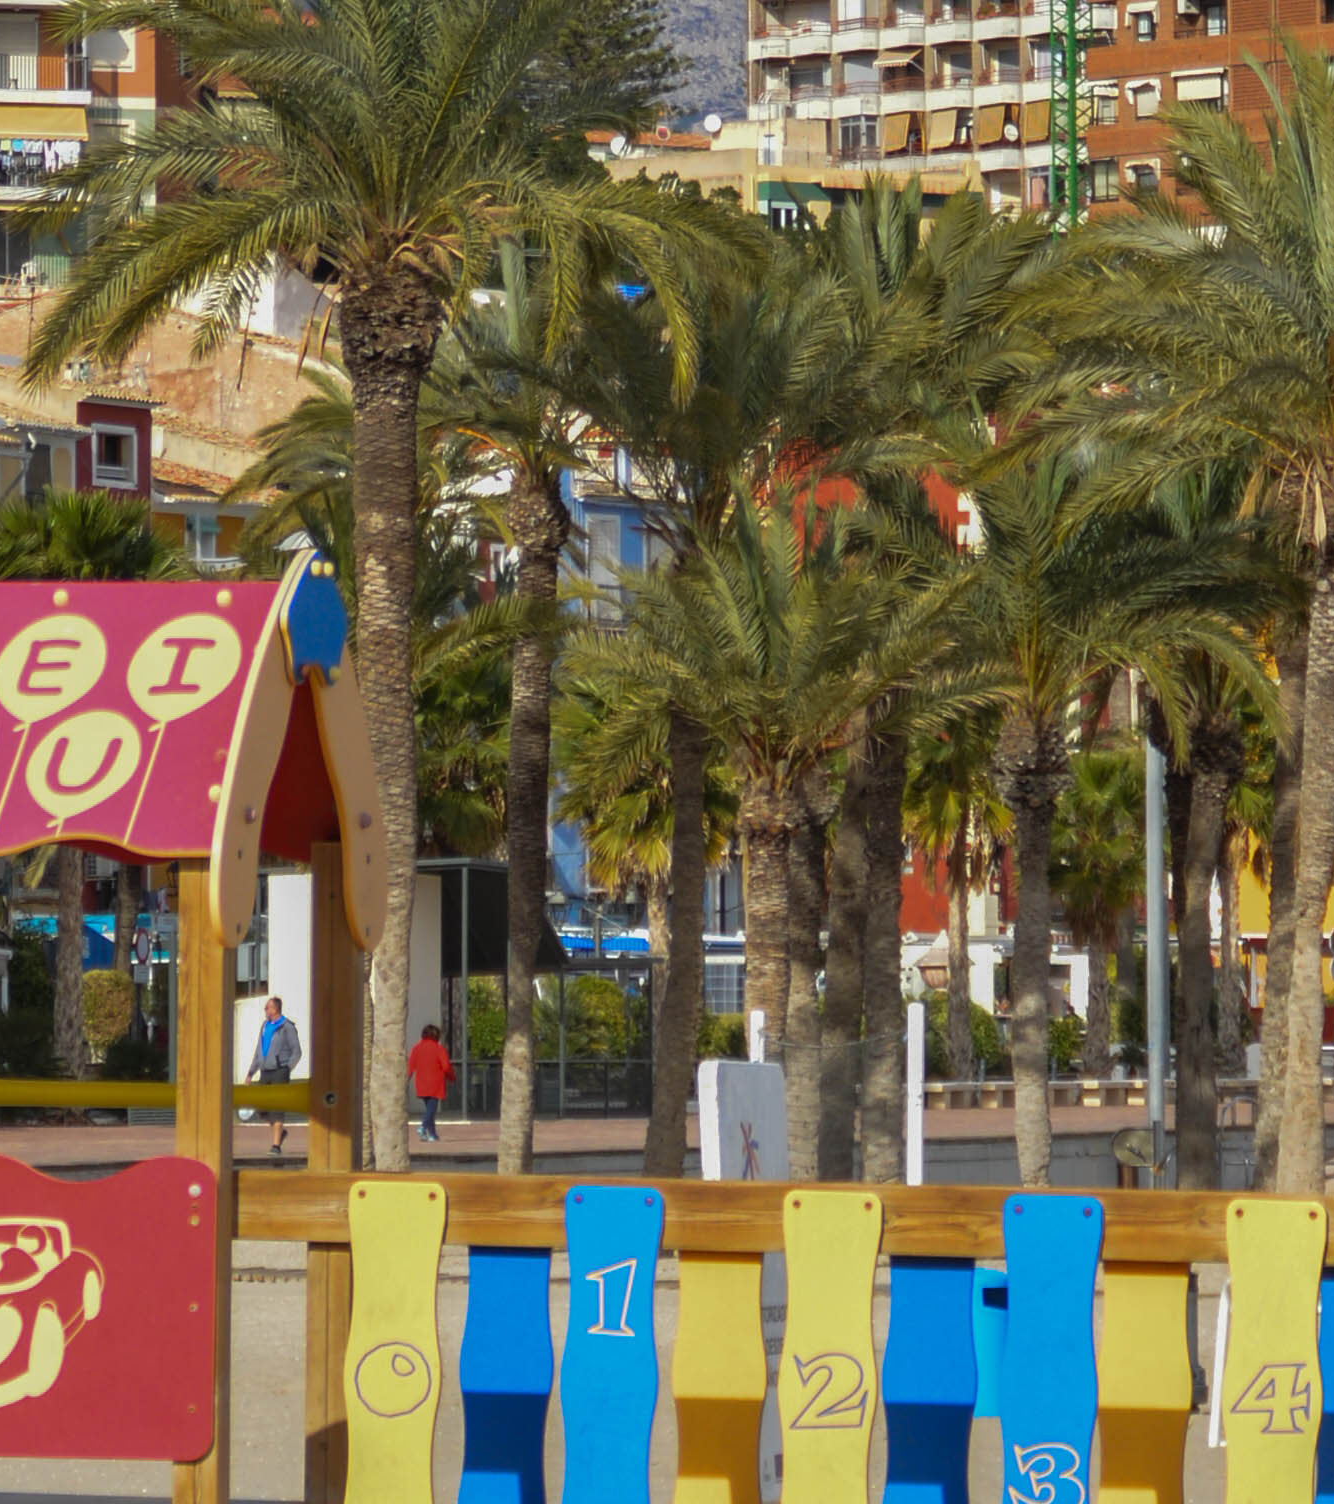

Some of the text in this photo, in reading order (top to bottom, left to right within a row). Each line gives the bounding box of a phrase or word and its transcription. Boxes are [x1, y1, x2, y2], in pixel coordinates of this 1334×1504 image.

[17, 639, 82, 696] E
[147, 637, 216, 696] I
[45, 736, 123, 795] U
[585, 1258, 637, 1337] 1
[789, 1353, 869, 1429] 2
[1230, 1362, 1311, 1435] 4
